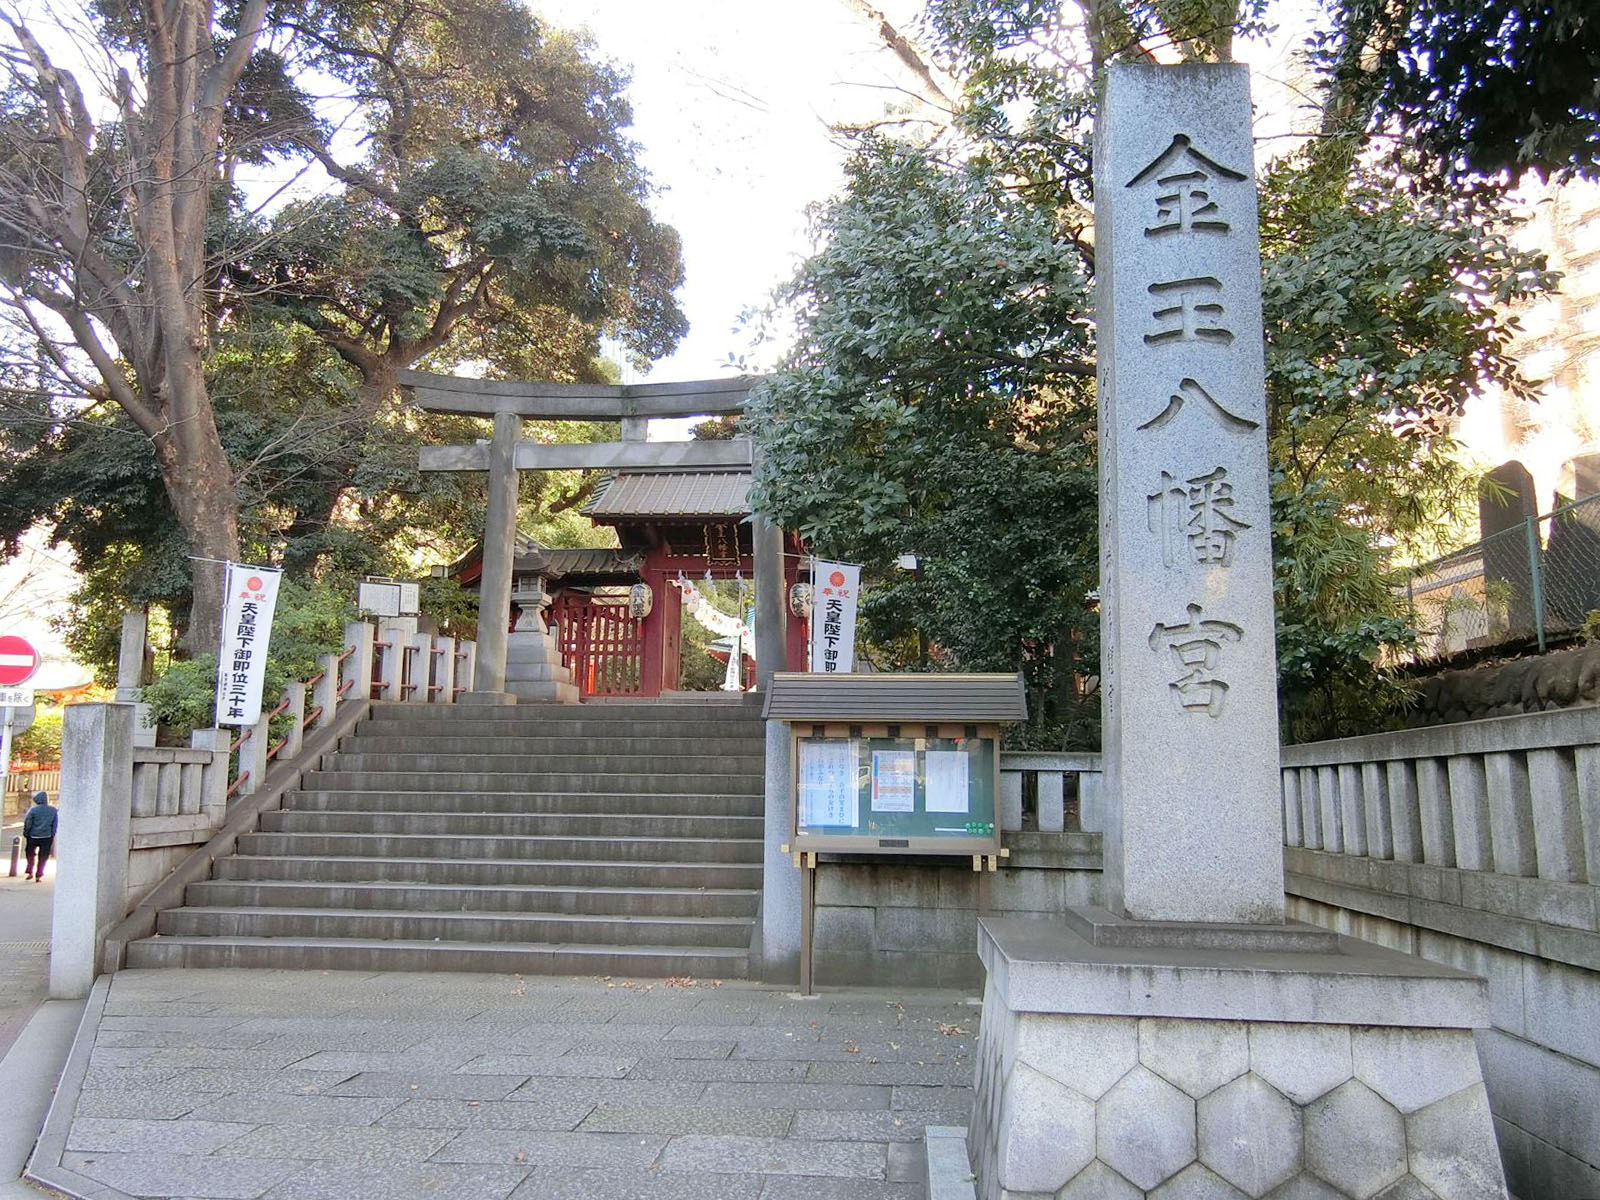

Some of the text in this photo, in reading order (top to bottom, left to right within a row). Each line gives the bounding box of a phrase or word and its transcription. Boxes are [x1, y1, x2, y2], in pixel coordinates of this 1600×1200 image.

[1125, 133, 1260, 719] 金王八幡宮
[821, 587, 850, 599] 奉祝
[824, 599, 843, 673] 天皇陛下御即
[227, 602, 259, 719] 天皇陛下御即位三十年
